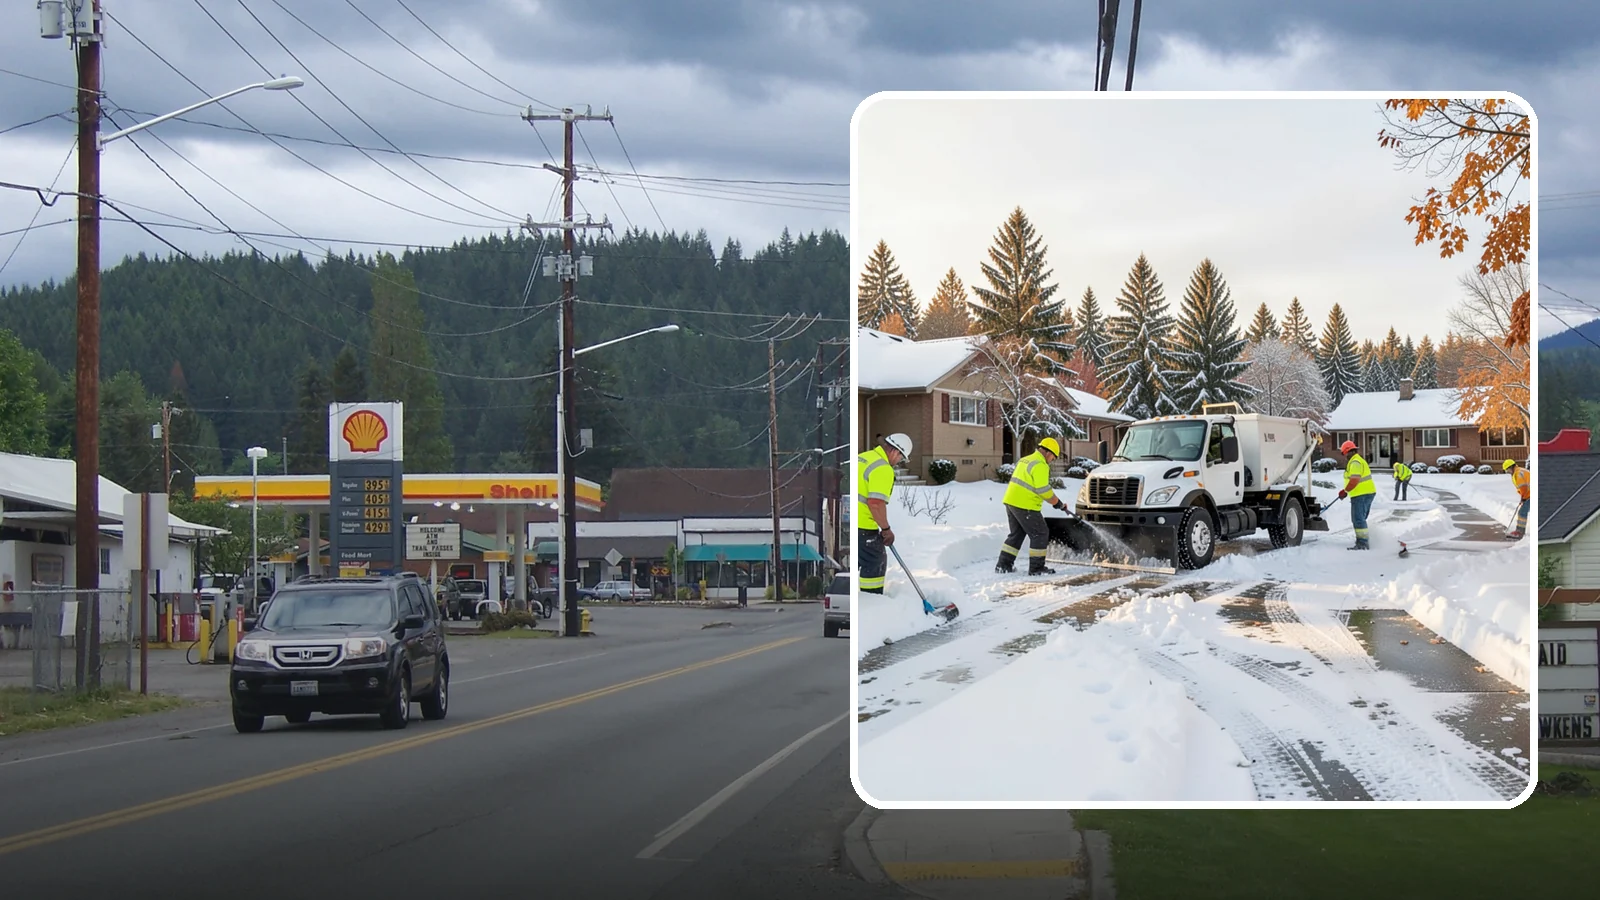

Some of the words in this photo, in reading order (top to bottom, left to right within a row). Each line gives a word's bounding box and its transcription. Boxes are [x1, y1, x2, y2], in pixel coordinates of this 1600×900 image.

[366, 480, 383, 490] 395
[490, 484, 547, 499] Shell
[366, 494, 383, 504] 405
[366, 508, 383, 518] 415
[366, 522, 383, 532] 429
